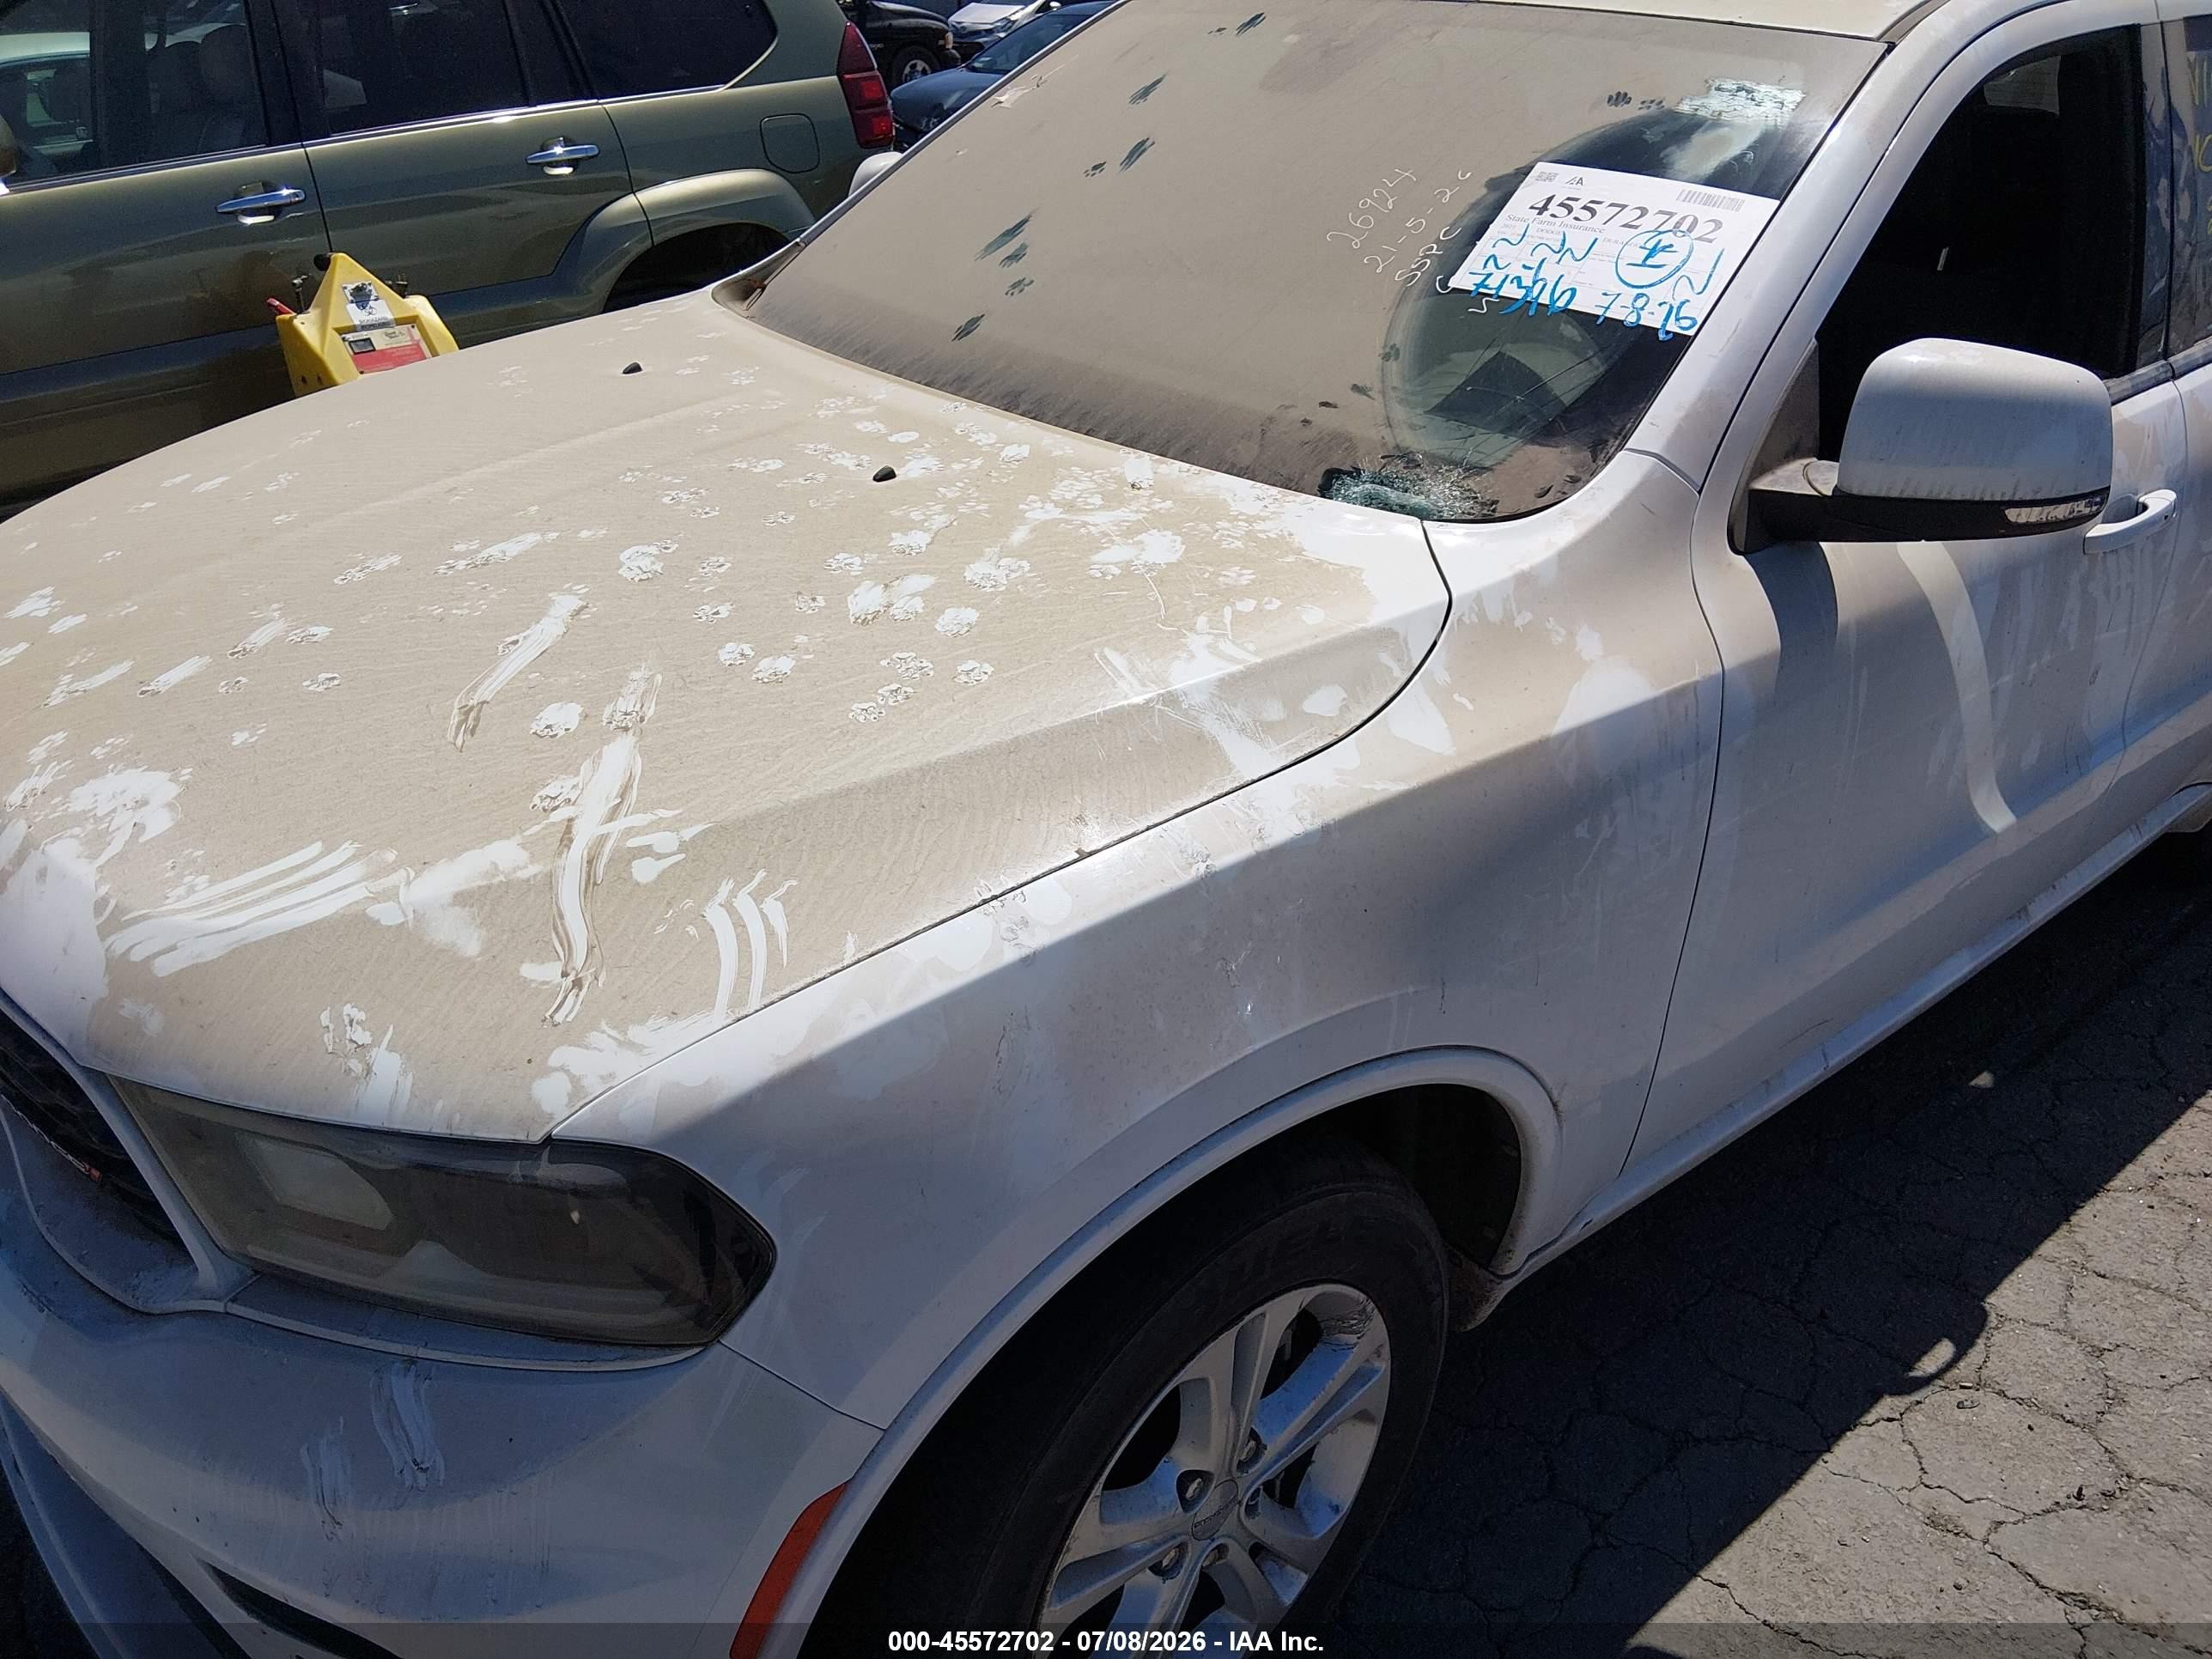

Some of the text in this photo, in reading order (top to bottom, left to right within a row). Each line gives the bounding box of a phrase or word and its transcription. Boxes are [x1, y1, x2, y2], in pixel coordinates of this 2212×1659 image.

[1327, 168, 1417, 249] 26924
[1504, 214, 1606, 234] State Farm Insurance
[1528, 193, 1723, 244] 45572702
